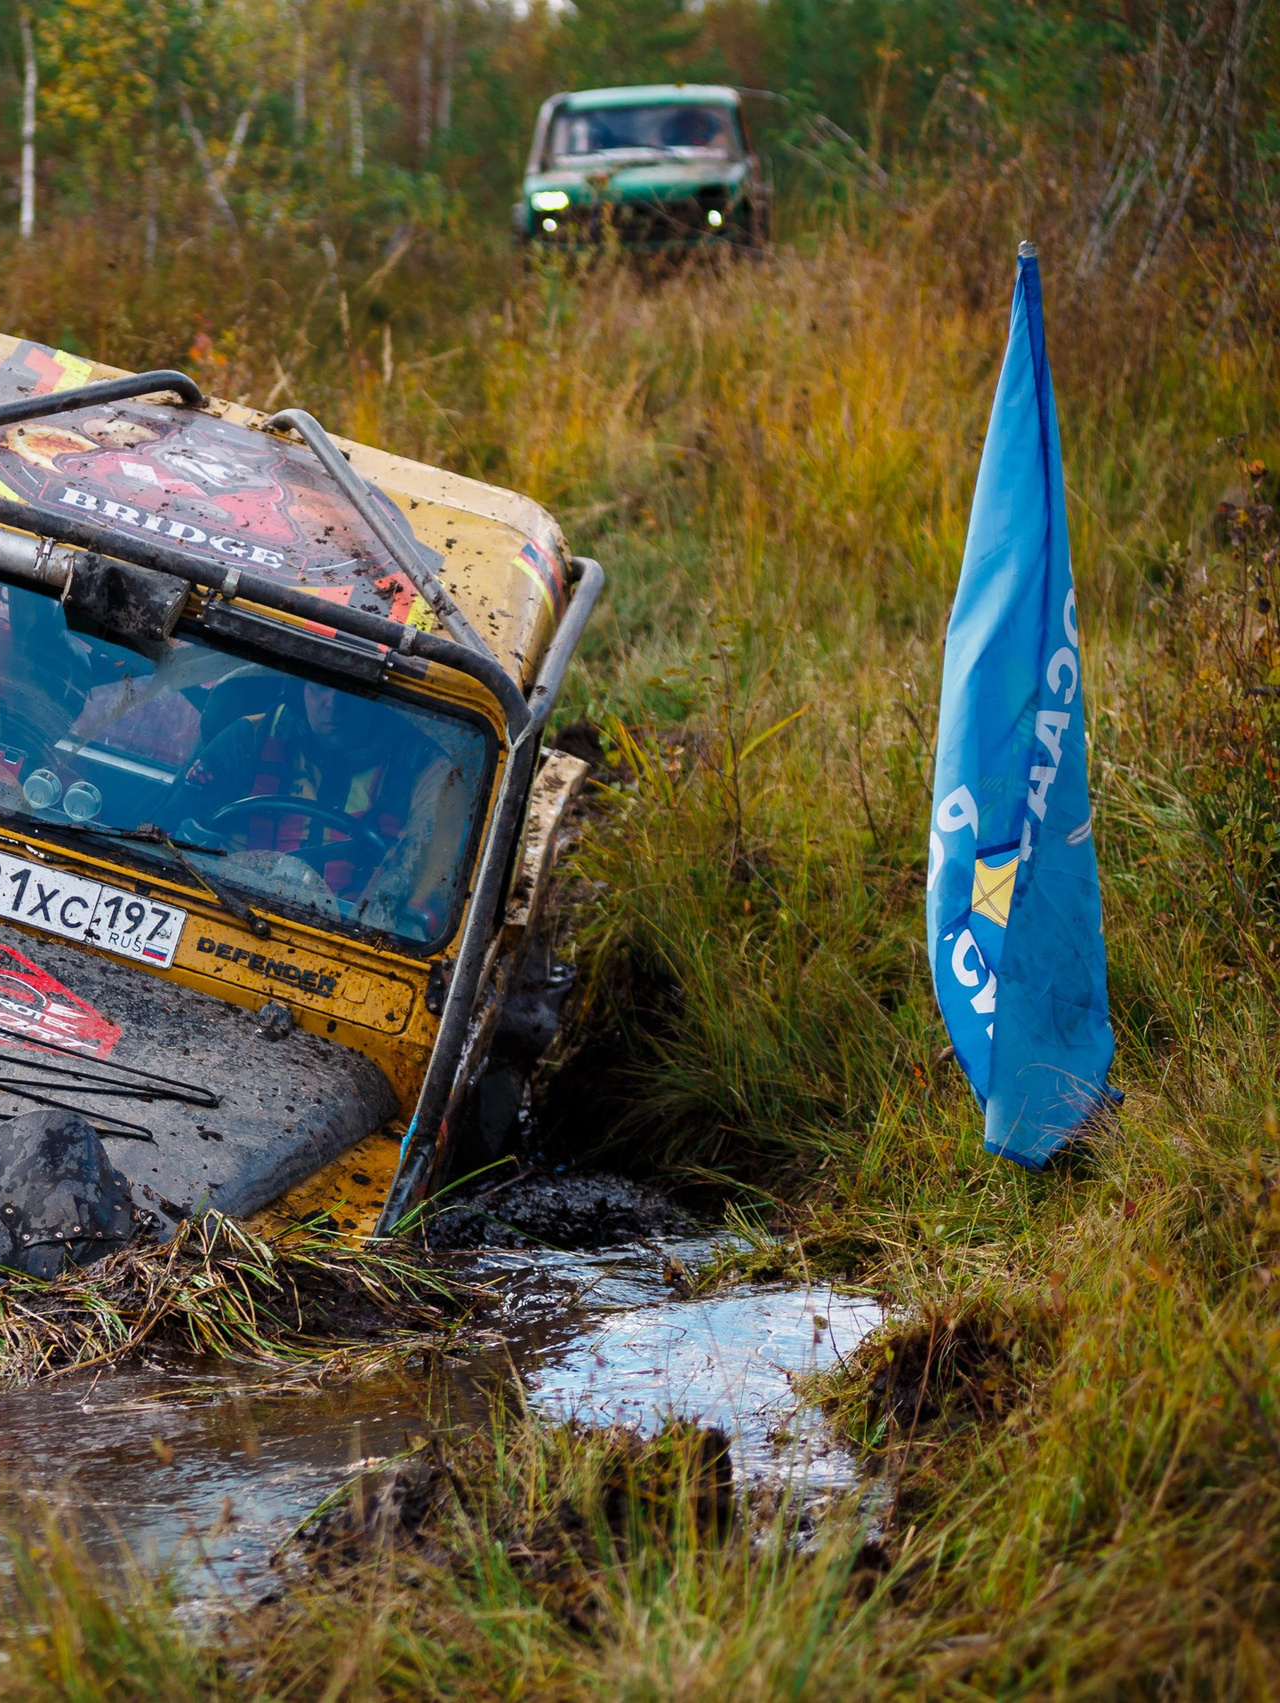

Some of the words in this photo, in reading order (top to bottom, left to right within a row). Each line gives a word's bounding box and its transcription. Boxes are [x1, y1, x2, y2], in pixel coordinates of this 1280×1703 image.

[58, 486, 285, 570] BRIDGE
[103, 895, 171, 942] 197
[108, 931, 144, 953] RUS
[195, 936, 337, 993] DEFENDER
